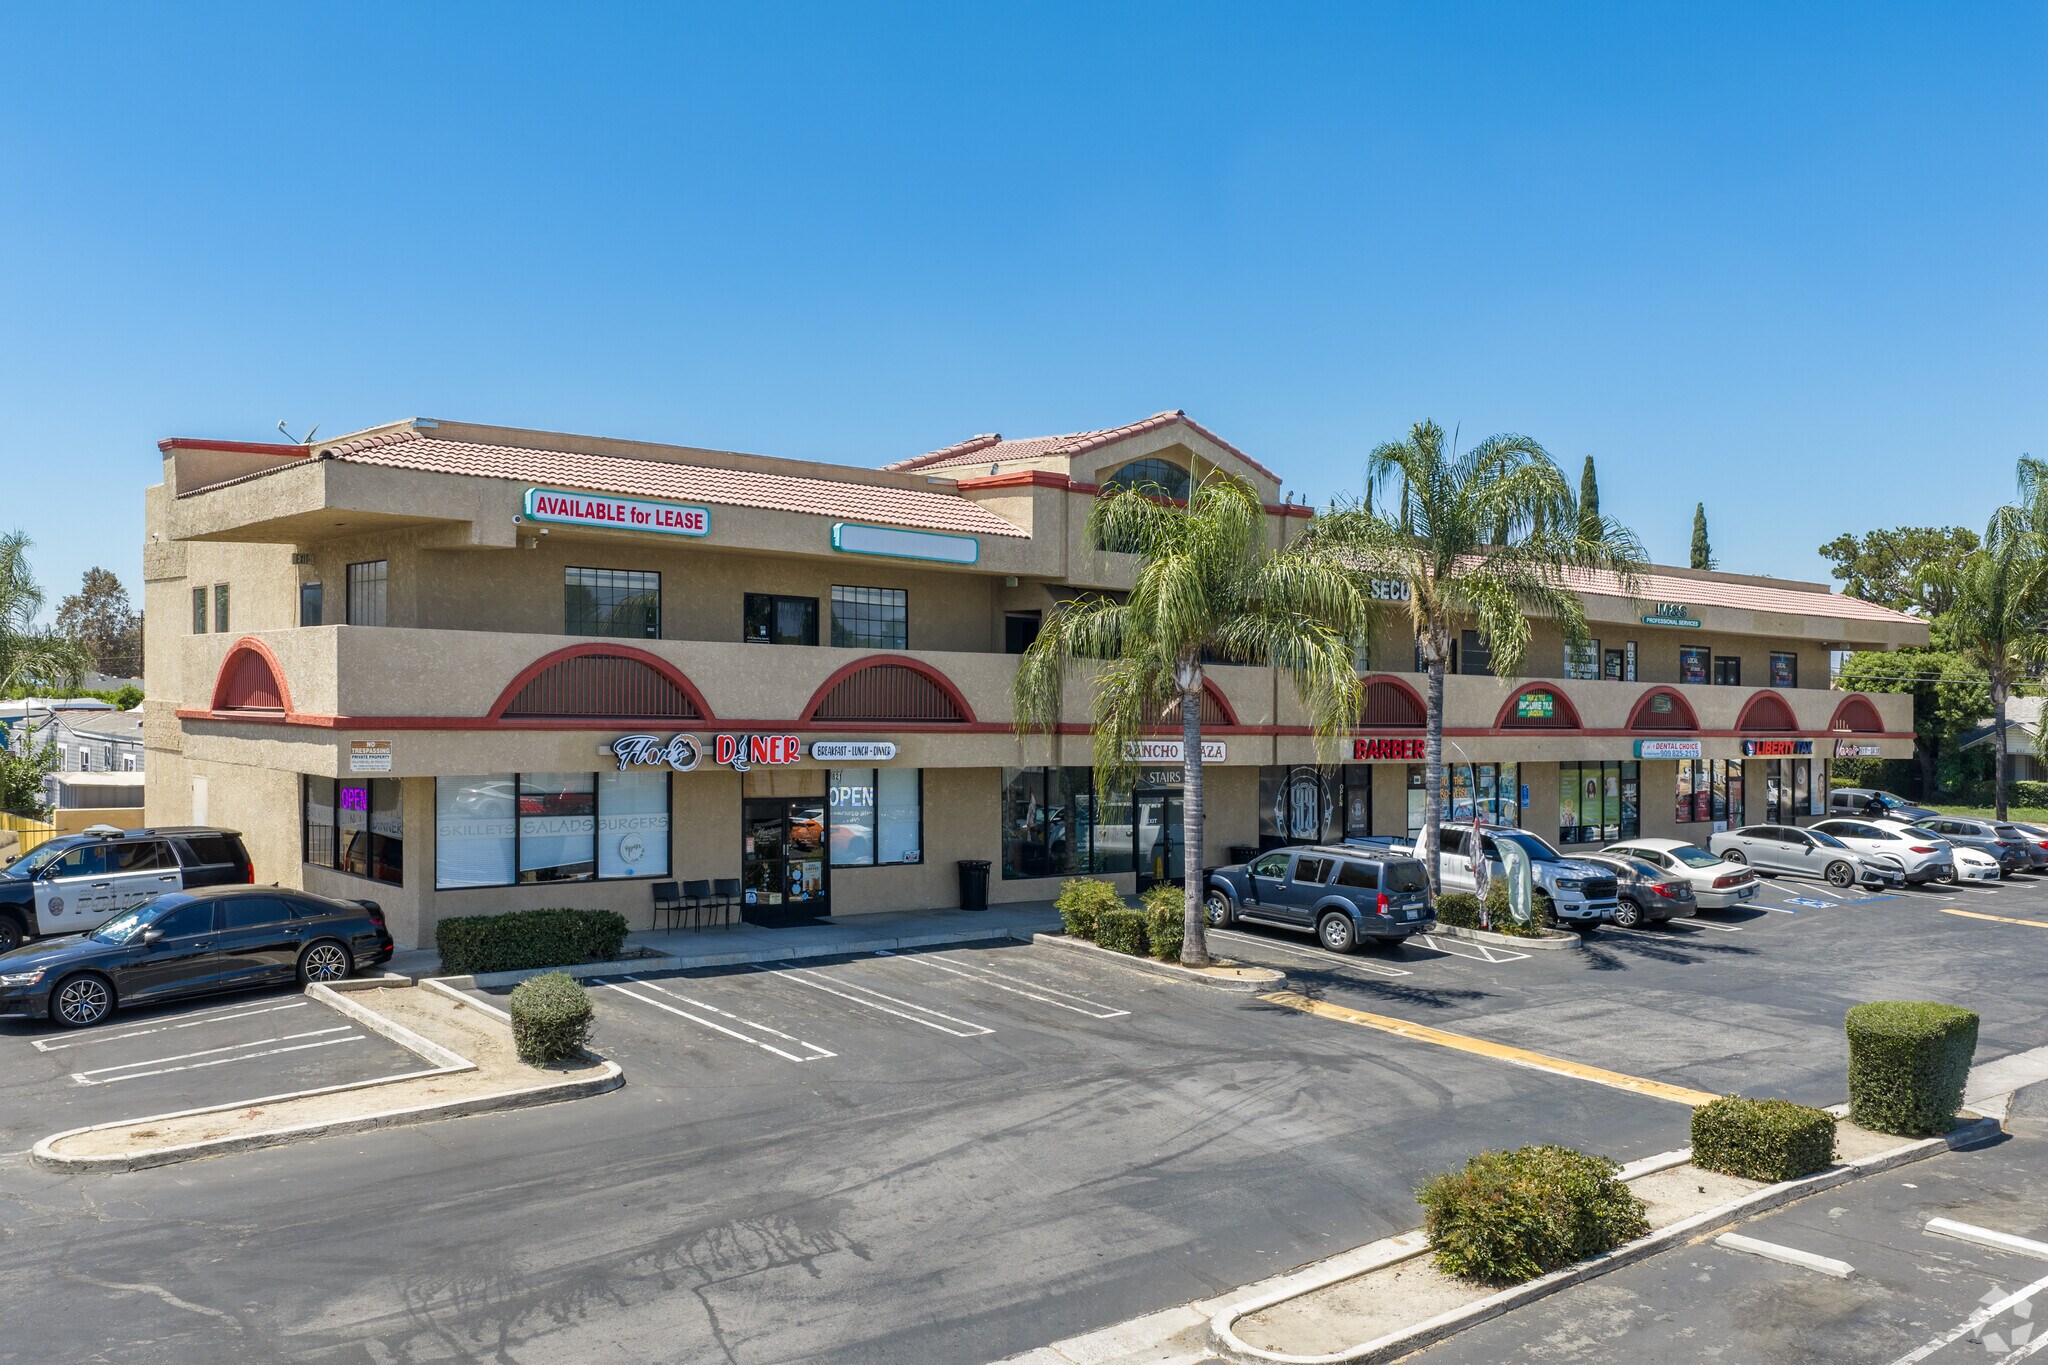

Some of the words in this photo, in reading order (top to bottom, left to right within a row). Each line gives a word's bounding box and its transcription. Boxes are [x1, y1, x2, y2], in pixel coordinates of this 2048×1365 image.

[537, 496, 626, 522] AVAILABLE
[630, 507, 652, 524] for
[655, 509, 704, 530] LEASE
[1646, 617, 1678, 625] PROFESSIONAL
[1627, 642, 1635, 681] NOTAR
[1518, 701, 1542, 710] INCOME
[1543, 701, 1553, 710] TAX
[817, 745, 847, 756] BREAKFAST
[852, 745, 869, 756] LUNCH
[873, 745, 892, 756] DINNER
[1200, 745, 1223, 758] AZA
[1355, 739, 1426, 760] BARBER
[1656, 742, 1678, 750] DENTAL
[1755, 741, 1795, 755] LIBERTY
[1795, 741, 1813, 754] TAX
[1150, 772, 1181, 783] STAIRS
[1453, 775, 1464, 786] THE
[341, 787, 367, 811] OPEN
[829, 786, 873, 807] OPEN
[439, 823, 516, 838] SKILLETS
[523, 818, 594, 834] SALADS
[599, 816, 669, 831] BURGERS
